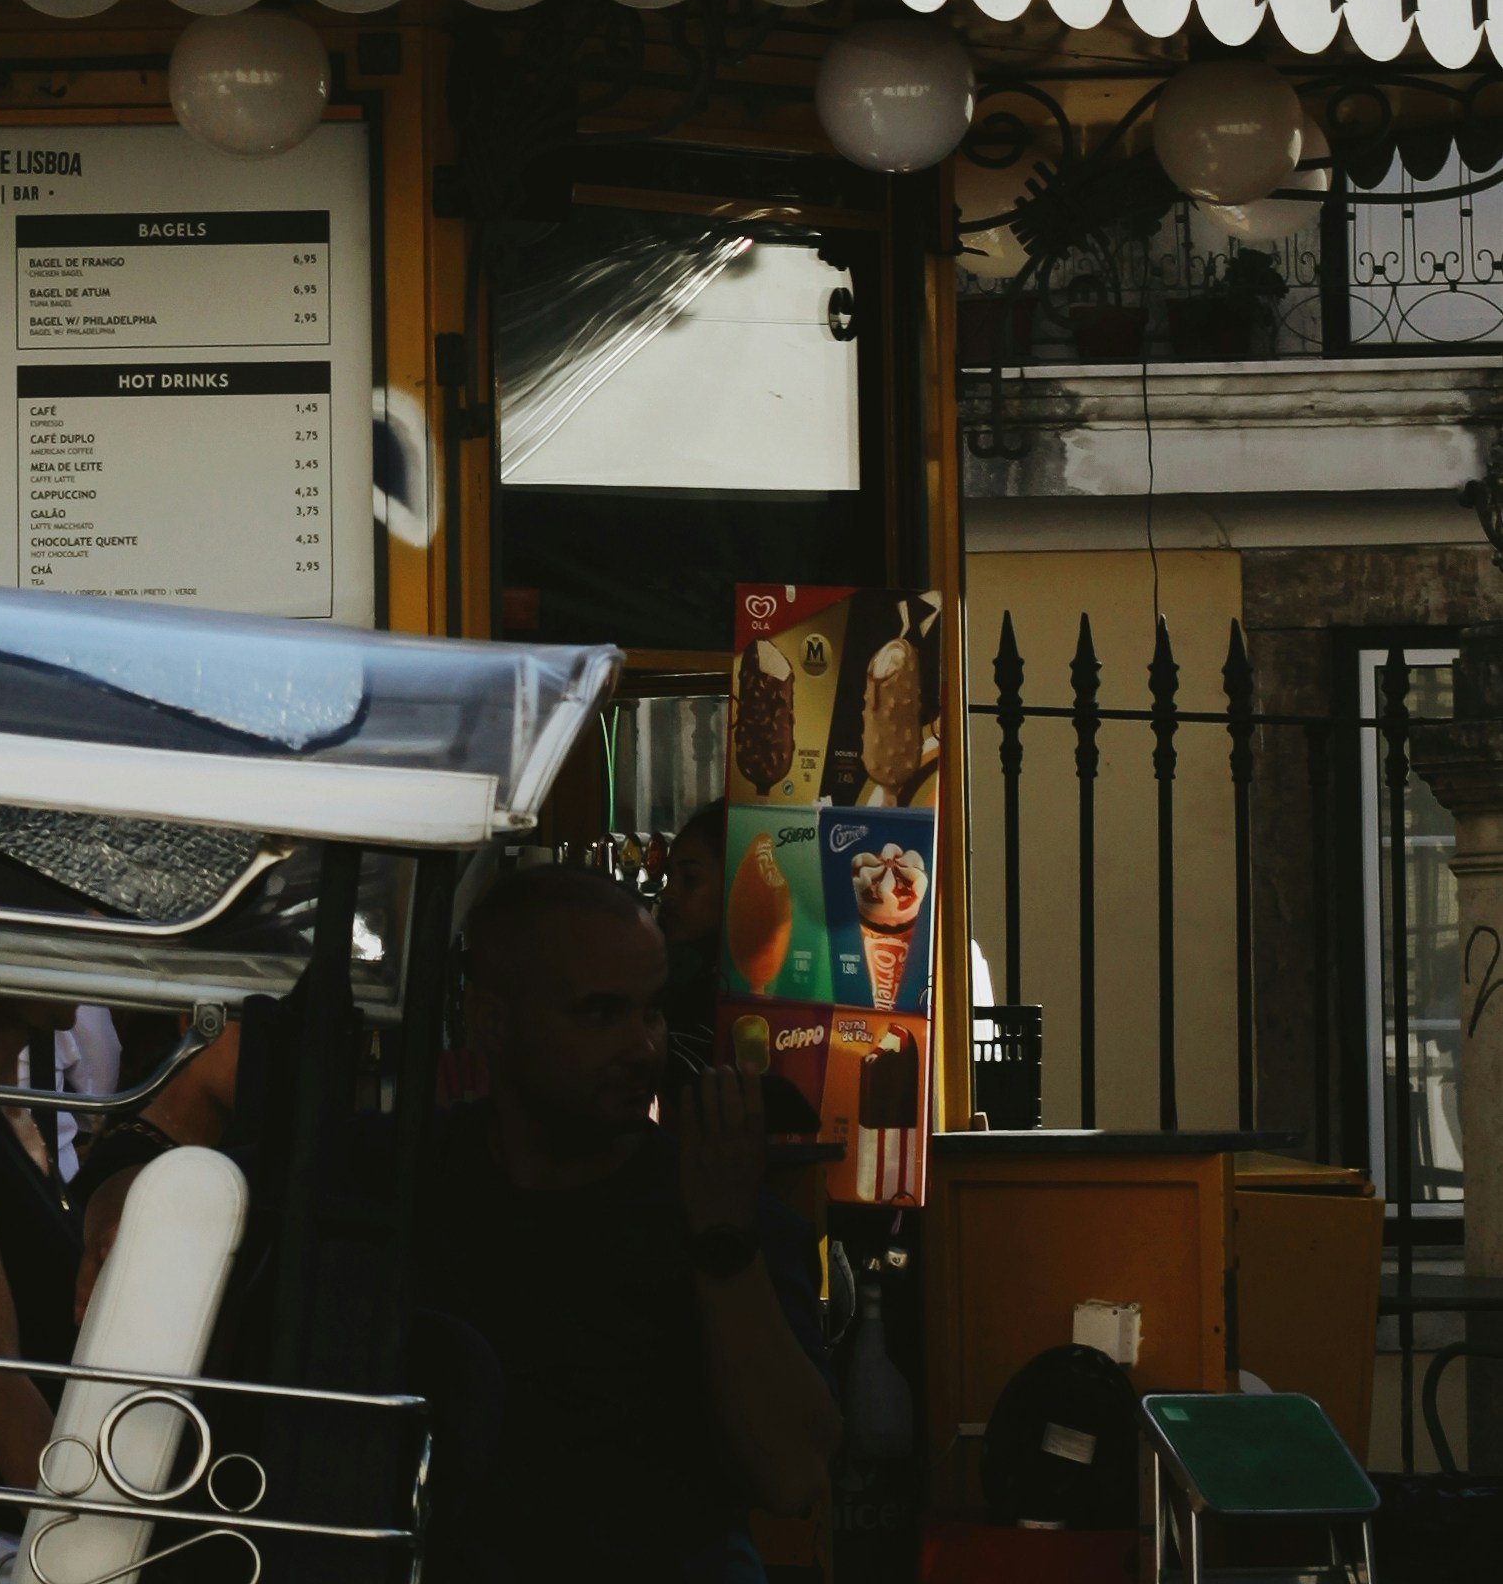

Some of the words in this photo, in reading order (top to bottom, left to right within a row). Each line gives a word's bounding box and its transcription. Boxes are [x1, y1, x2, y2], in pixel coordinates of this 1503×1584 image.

[17, 151, 82, 176] LISBOA
[13, 186, 39, 201] BAR
[139, 223, 206, 236] BAGELS
[30, 259, 62, 267] BAGEL
[66, 258, 78, 267] DE
[82, 258, 125, 266] FRANGO
[293, 255, 316, 264] 6,95
[30, 289, 62, 298] BAGEL
[66, 288, 78, 297] DE
[82, 288, 110, 296] ATUM
[294, 285, 316, 294] 6,95
[30, 317, 63, 326] BAGEL
[65, 317, 80, 325] W/
[83, 316, 157, 325] PHILADELPHIA
[295, 313, 317, 322] 2,95
[119, 375, 154, 388] HOT
[162, 374, 228, 387] DRINKS
[30, 407, 56, 415] CAFÉ
[296, 403, 317, 412] 1,45
[31, 435, 56, 444] CAFÉ
[60, 435, 95, 443] DUPLO
[296, 431, 318, 440] 2,75
[31, 463, 55, 471] MEIA
[58, 462, 70, 471] DE
[75, 462, 102, 471] LEITE
[295, 460, 318, 469] 3,45
[31, 491, 96, 499] CAPPUCCINO
[295, 487, 318, 496] 4,25
[31, 510, 66, 518] GALÃO
[297, 506, 318, 515] 3,75
[31, 537, 92, 546] CHOCOLATE
[96, 537, 137, 546] QUENTE
[296, 534, 319, 543] 4,25
[31, 566, 52, 574] CHÁ
[296, 562, 319, 571] 2,95
[752, 621, 769, 630] OLA
